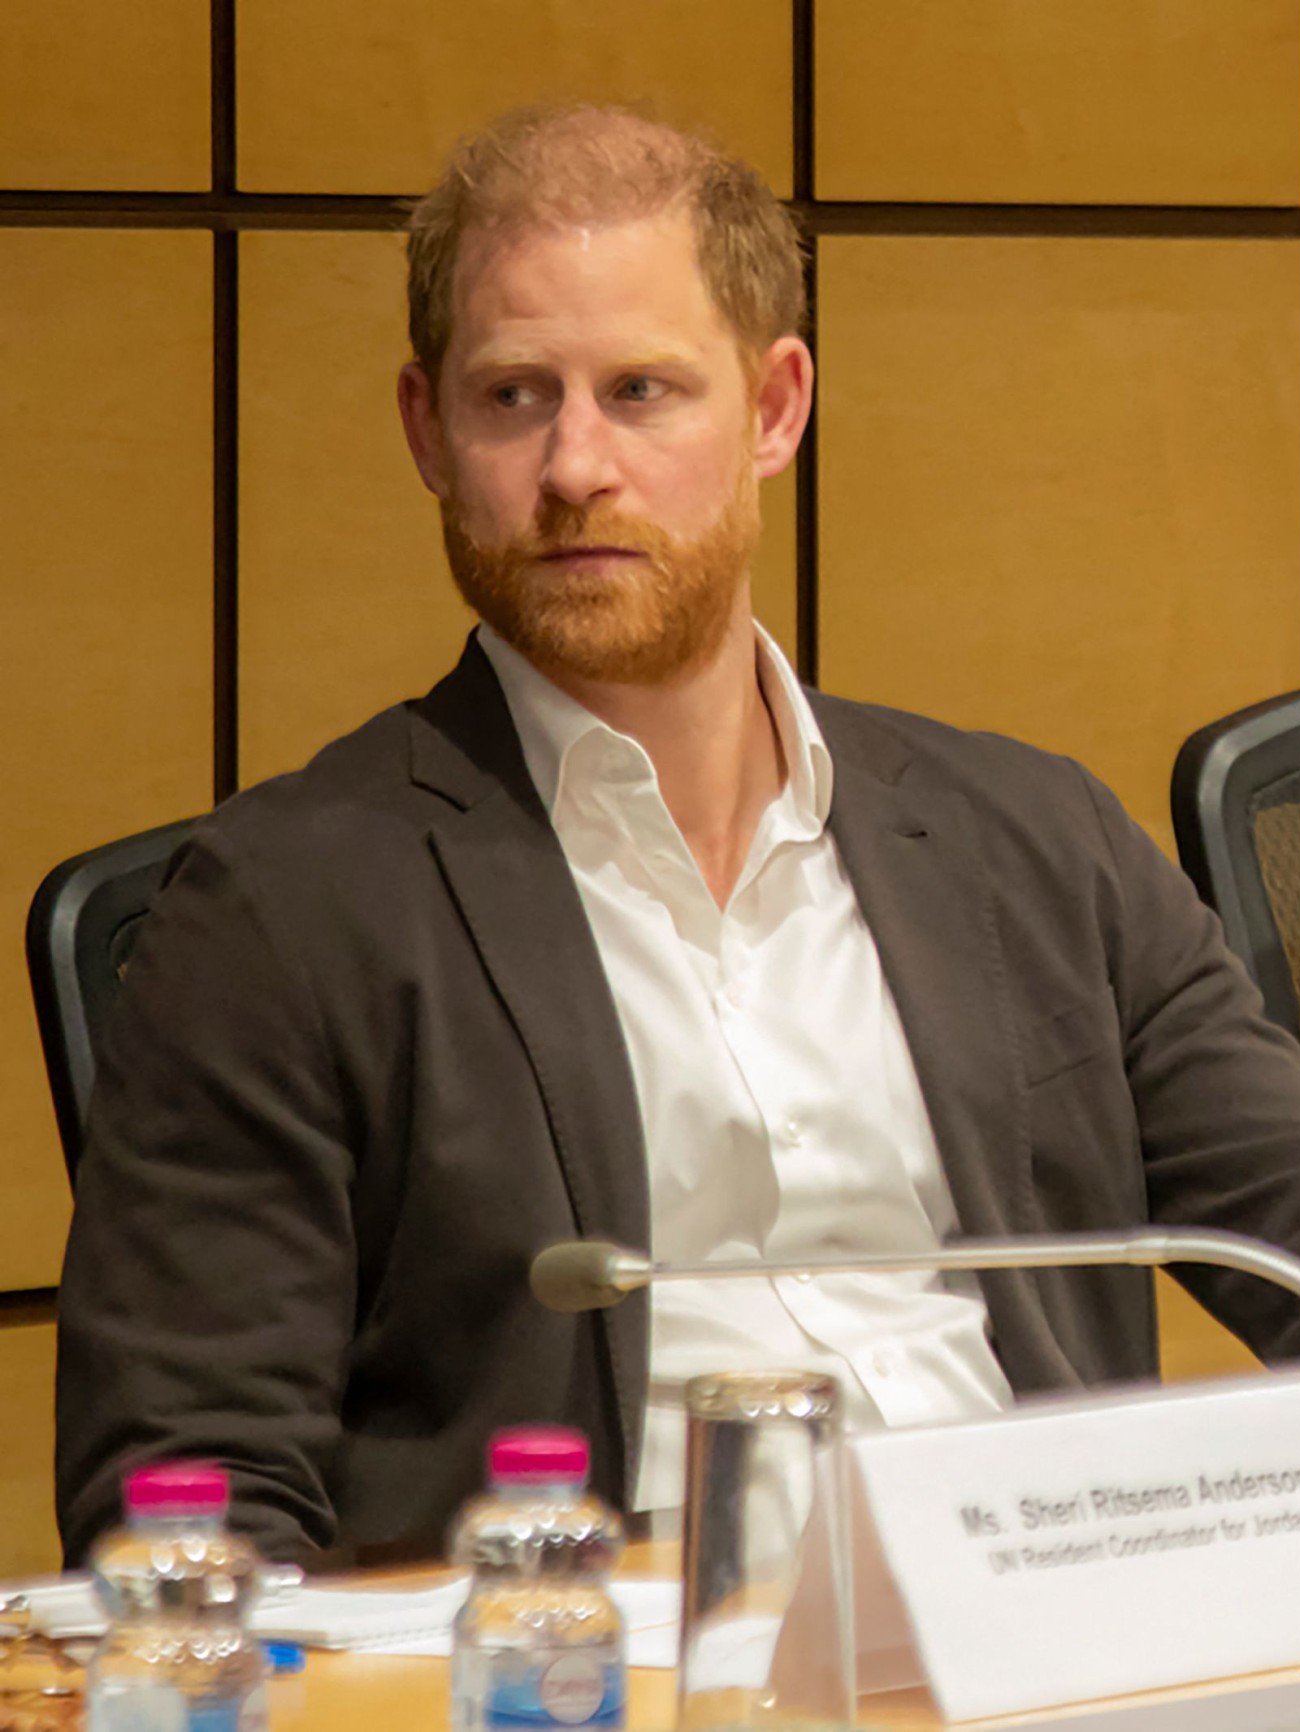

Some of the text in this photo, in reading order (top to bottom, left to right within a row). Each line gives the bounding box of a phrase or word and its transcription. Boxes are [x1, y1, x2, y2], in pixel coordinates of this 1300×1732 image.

[960, 1504, 1009, 1537] Ms.
[1018, 1490, 1088, 1531] Sheri
[1090, 1485, 1192, 1520] Ritsema
[1021, 1539, 1104, 1570] Resident
[1108, 1523, 1216, 1560] Coordinator
[1219, 1516, 1247, 1542] for
